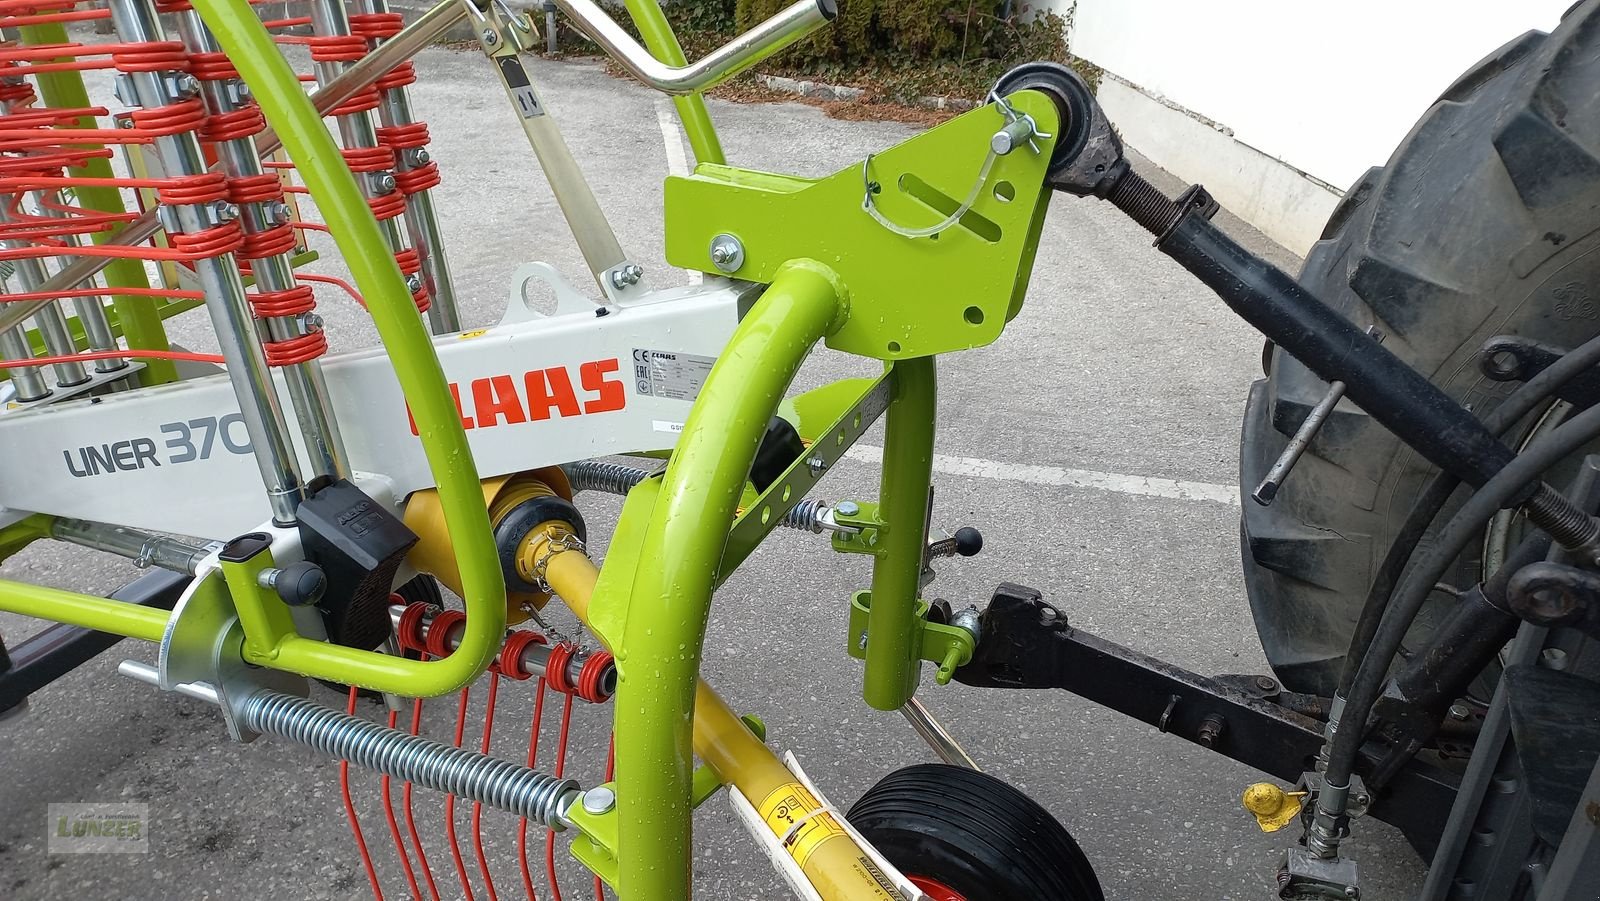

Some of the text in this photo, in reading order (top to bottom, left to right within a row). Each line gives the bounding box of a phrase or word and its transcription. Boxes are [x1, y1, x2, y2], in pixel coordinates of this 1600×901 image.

[633, 349, 649, 362] CE
[405, 358, 626, 436] LAAS
[63, 413, 254, 477] LINER 370
